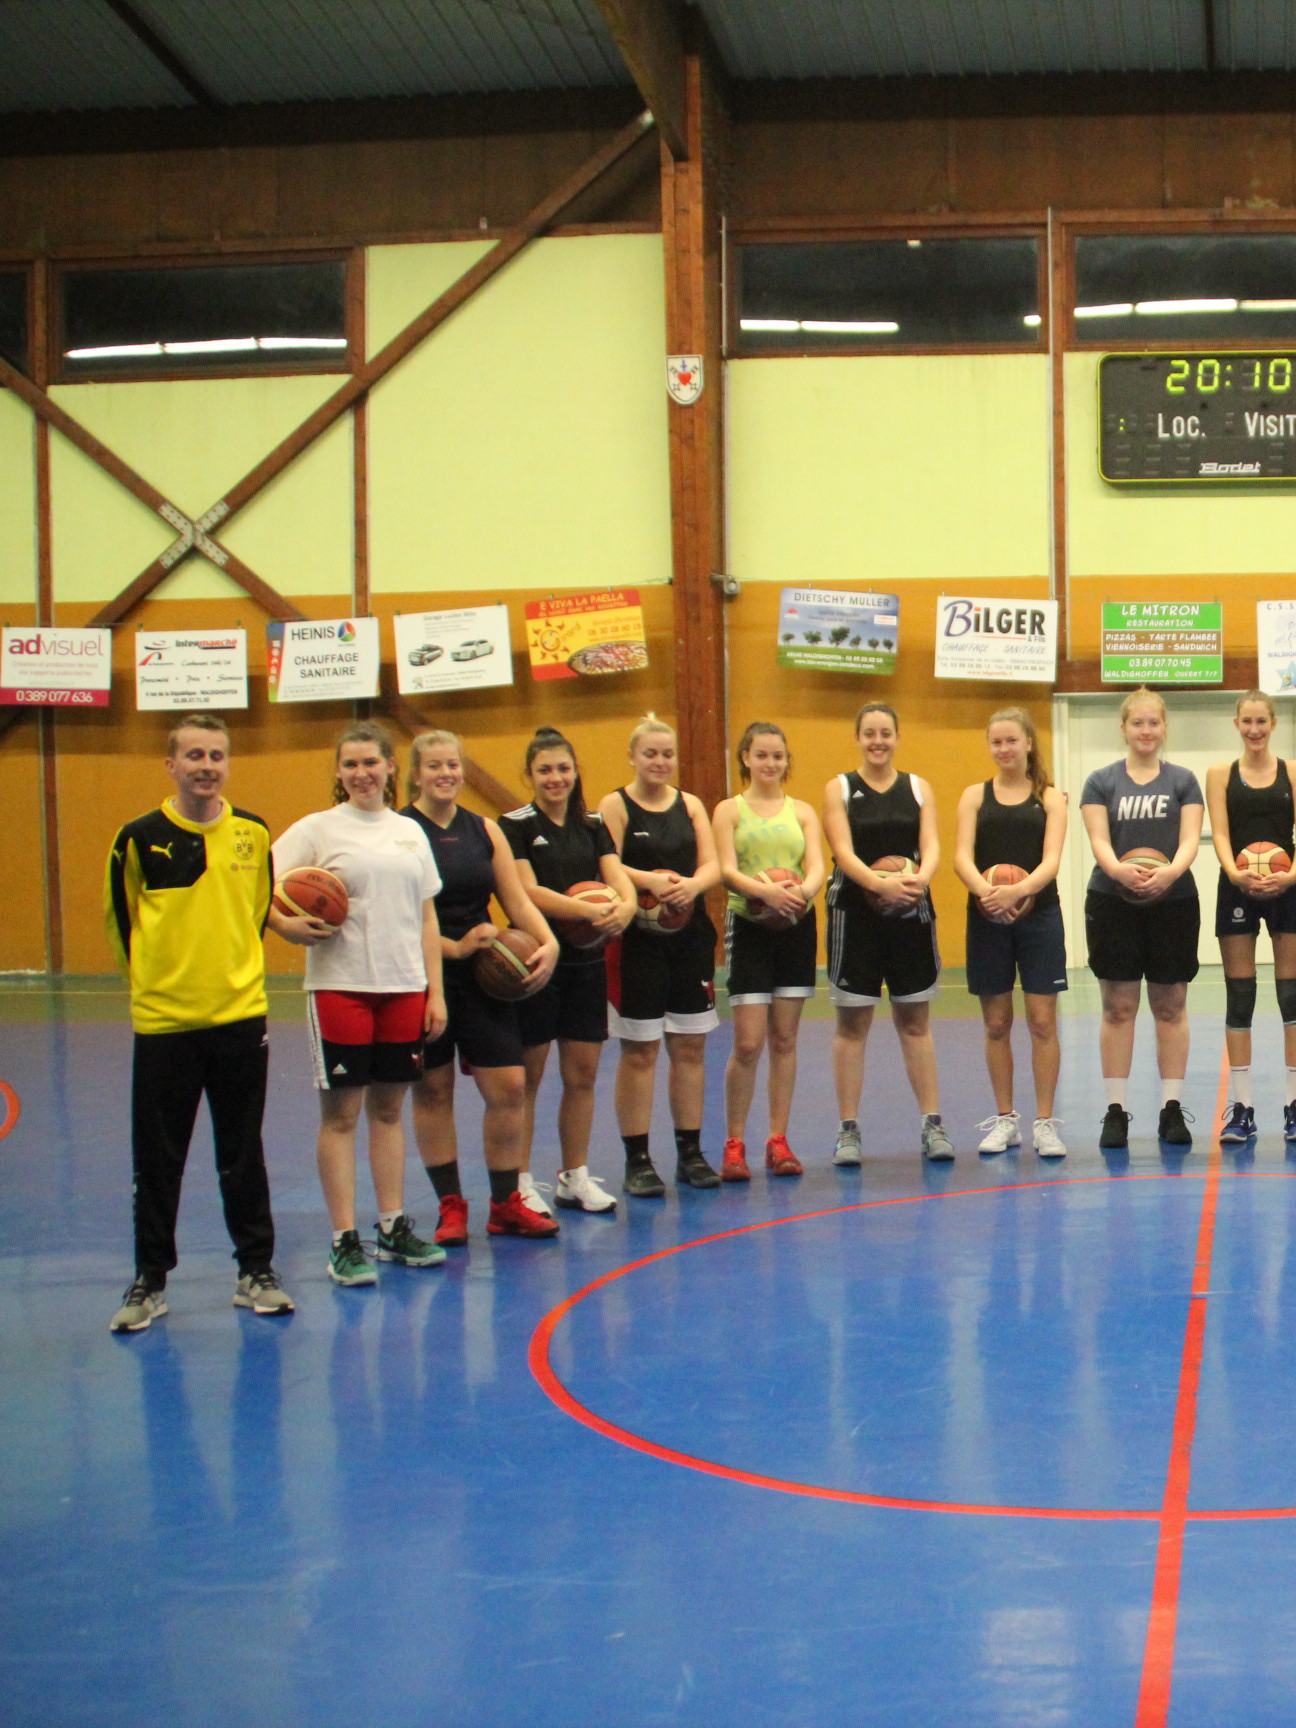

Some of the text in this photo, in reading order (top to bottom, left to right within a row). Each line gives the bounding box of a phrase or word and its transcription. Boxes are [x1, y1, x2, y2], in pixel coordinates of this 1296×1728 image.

[1166, 358, 1292, 393] 20:10
[1199, 462, 1261, 474] Bodet
[549, 598, 573, 609] VIVA
[575, 596, 588, 606] LA
[590, 592, 625, 604] PAELLA
[794, 592, 890, 607] DIETSCHY MULLER
[1121, 604, 1138, 616] LE
[1126, 619, 1194, 627] RESTAURATION
[291, 626, 336, 641] HEINIS
[1105, 633, 1137, 641] PIZZAS
[1149, 633, 1177, 641] TARTE
[1179, 633, 1217, 641] FLAMBEE
[8, 633, 104, 656] advisuel
[942, 642, 1047, 654] CHAUFFAGE SANITAIRE
[1173, 643, 1217, 651] SANDWICH
[294, 652, 360, 666] CHAUFFAGE
[1154, 658, 1165, 667] 07
[1167, 658, 1179, 667] 70
[1179, 658, 1192, 667] 45
[299, 666, 357, 679] SANITAIRE
[1104, 670, 1169, 678] WALDIGHOFFEN
[1117, 795, 1170, 821] NIKE
